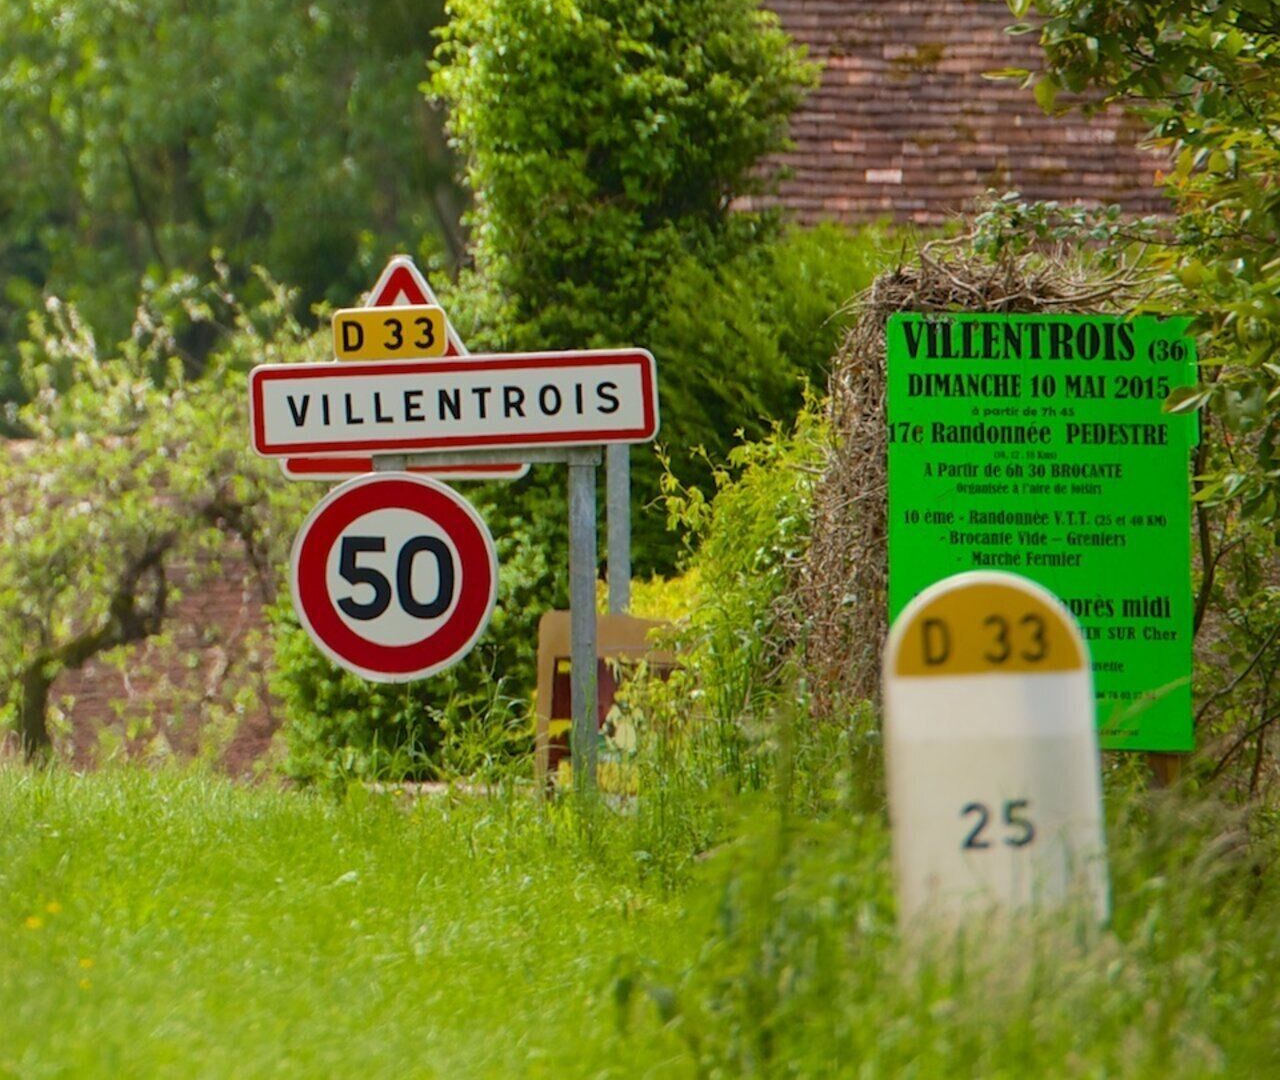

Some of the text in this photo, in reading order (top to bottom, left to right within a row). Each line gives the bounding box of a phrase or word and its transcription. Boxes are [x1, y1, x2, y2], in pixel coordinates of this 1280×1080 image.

[342, 317, 435, 353] D 33
[902, 322, 1135, 360] VILLENTROIS
[908, 373, 1170, 400] DIMANCHE 10 MAI 2015
[286, 381, 621, 427] VILLENTROIS
[984, 406, 1019, 418] partir
[1023, 406, 1038, 417] de
[1042, 407, 1056, 417] 7h
[1060, 408, 1075, 417] 45
[890, 422, 1168, 446] 17e Randonnée PEDESTRE
[938, 463, 979, 477] Partir
[984, 463, 1002, 477] de
[1006, 463, 1023, 478] 6h
[1028, 464, 1046, 478] 30
[1052, 464, 1123, 478] BROCANTE
[1054, 483, 1067, 494] de
[970, 510, 1049, 526] Randonnée
[950, 531, 1013, 545] Brocante
[1018, 531, 1047, 546] Vide
[1067, 532, 1127, 547] Greniers
[972, 551, 1020, 566] Marché
[1026, 552, 1082, 567] Fermier
[337, 535, 455, 621] 50
[1122, 595, 1171, 618] midi
[920, 613, 1050, 666] D 33
[1107, 626, 1136, 640] SUR
[1142, 626, 1177, 641] Cher
[960, 798, 1036, 850] 25
